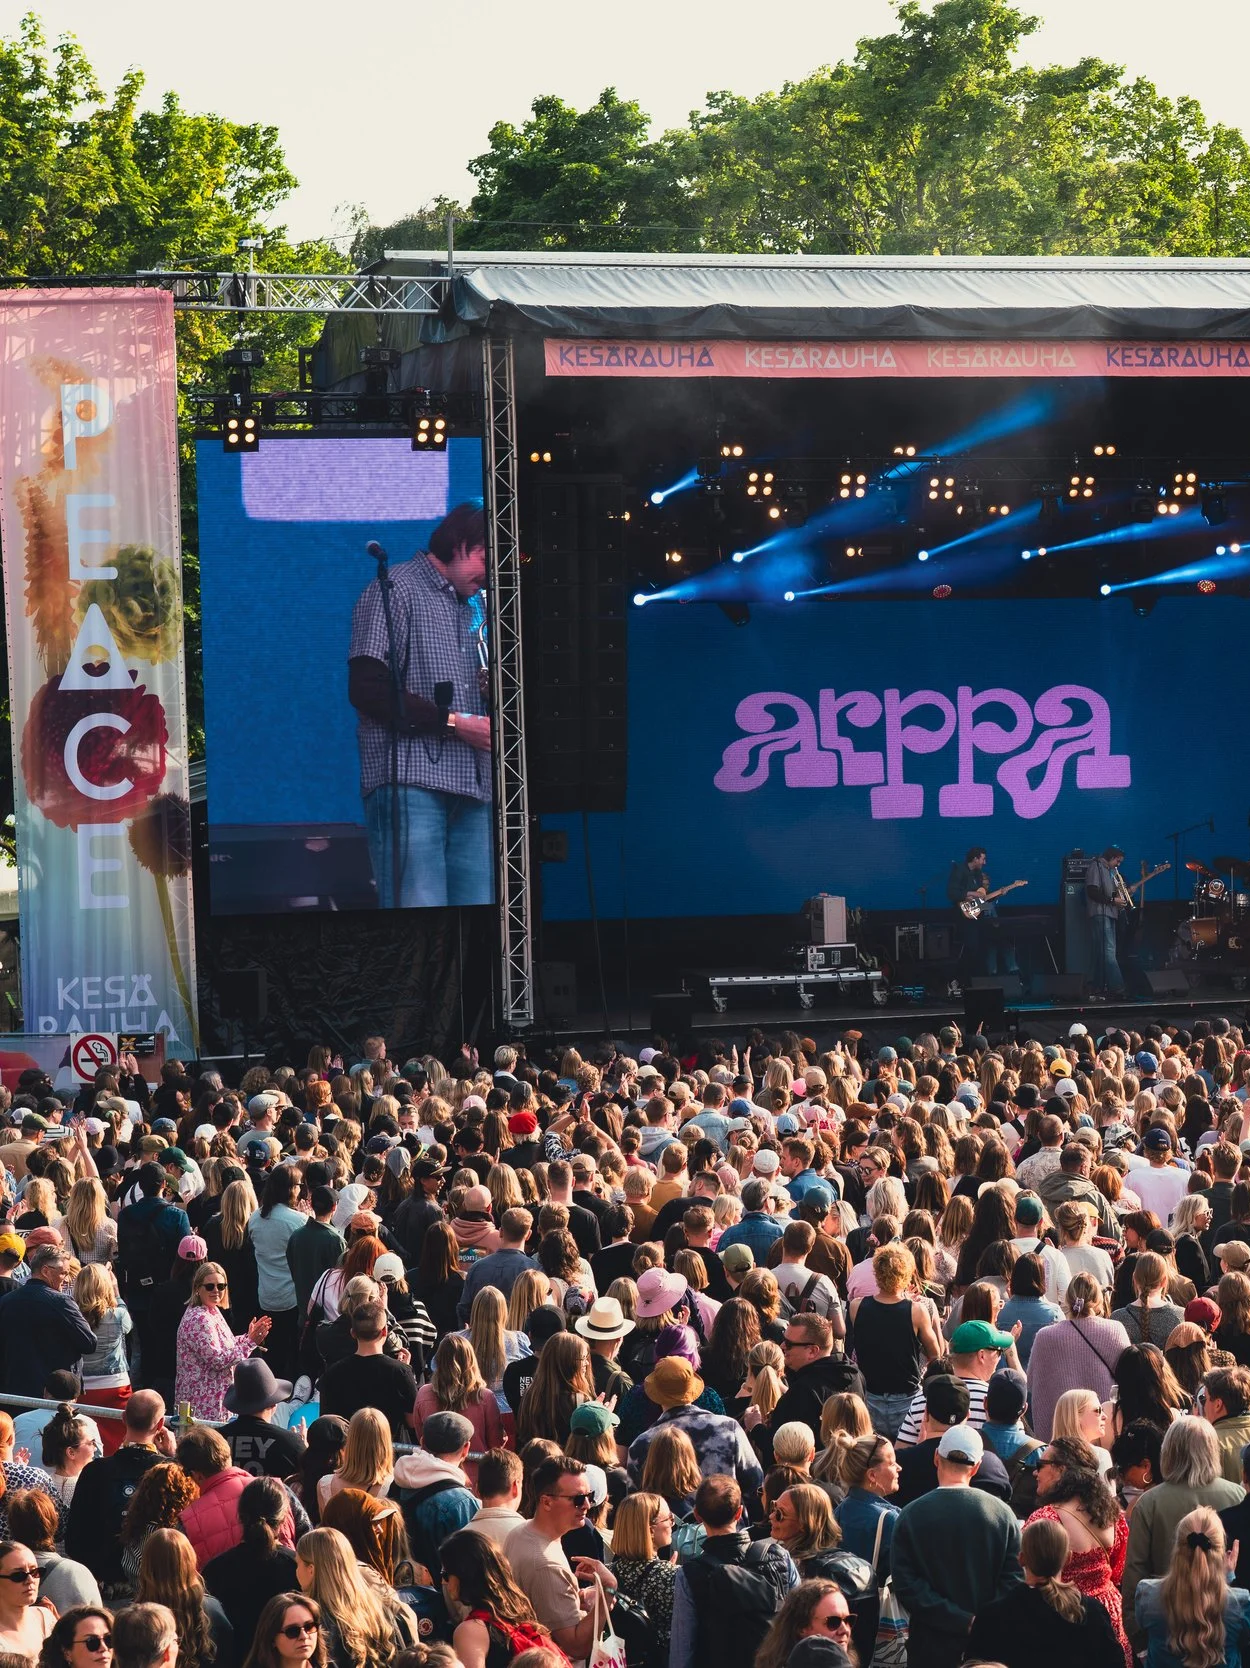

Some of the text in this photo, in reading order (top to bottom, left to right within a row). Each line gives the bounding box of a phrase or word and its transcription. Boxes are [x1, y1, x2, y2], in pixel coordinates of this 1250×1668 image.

[560, 346, 715, 368] KESÄRAUHA
[745, 347, 897, 369] KESÄRAUHA
[927, 347, 1077, 368] KESÄRAUHA
[1106, 347, 1250, 368] KESÄRAUHA
[58, 384, 136, 909] PEACE
[713, 685, 1131, 819] arppa
[57, 973, 158, 1010] KESÄ
[228, 1436, 276, 1459] EY
